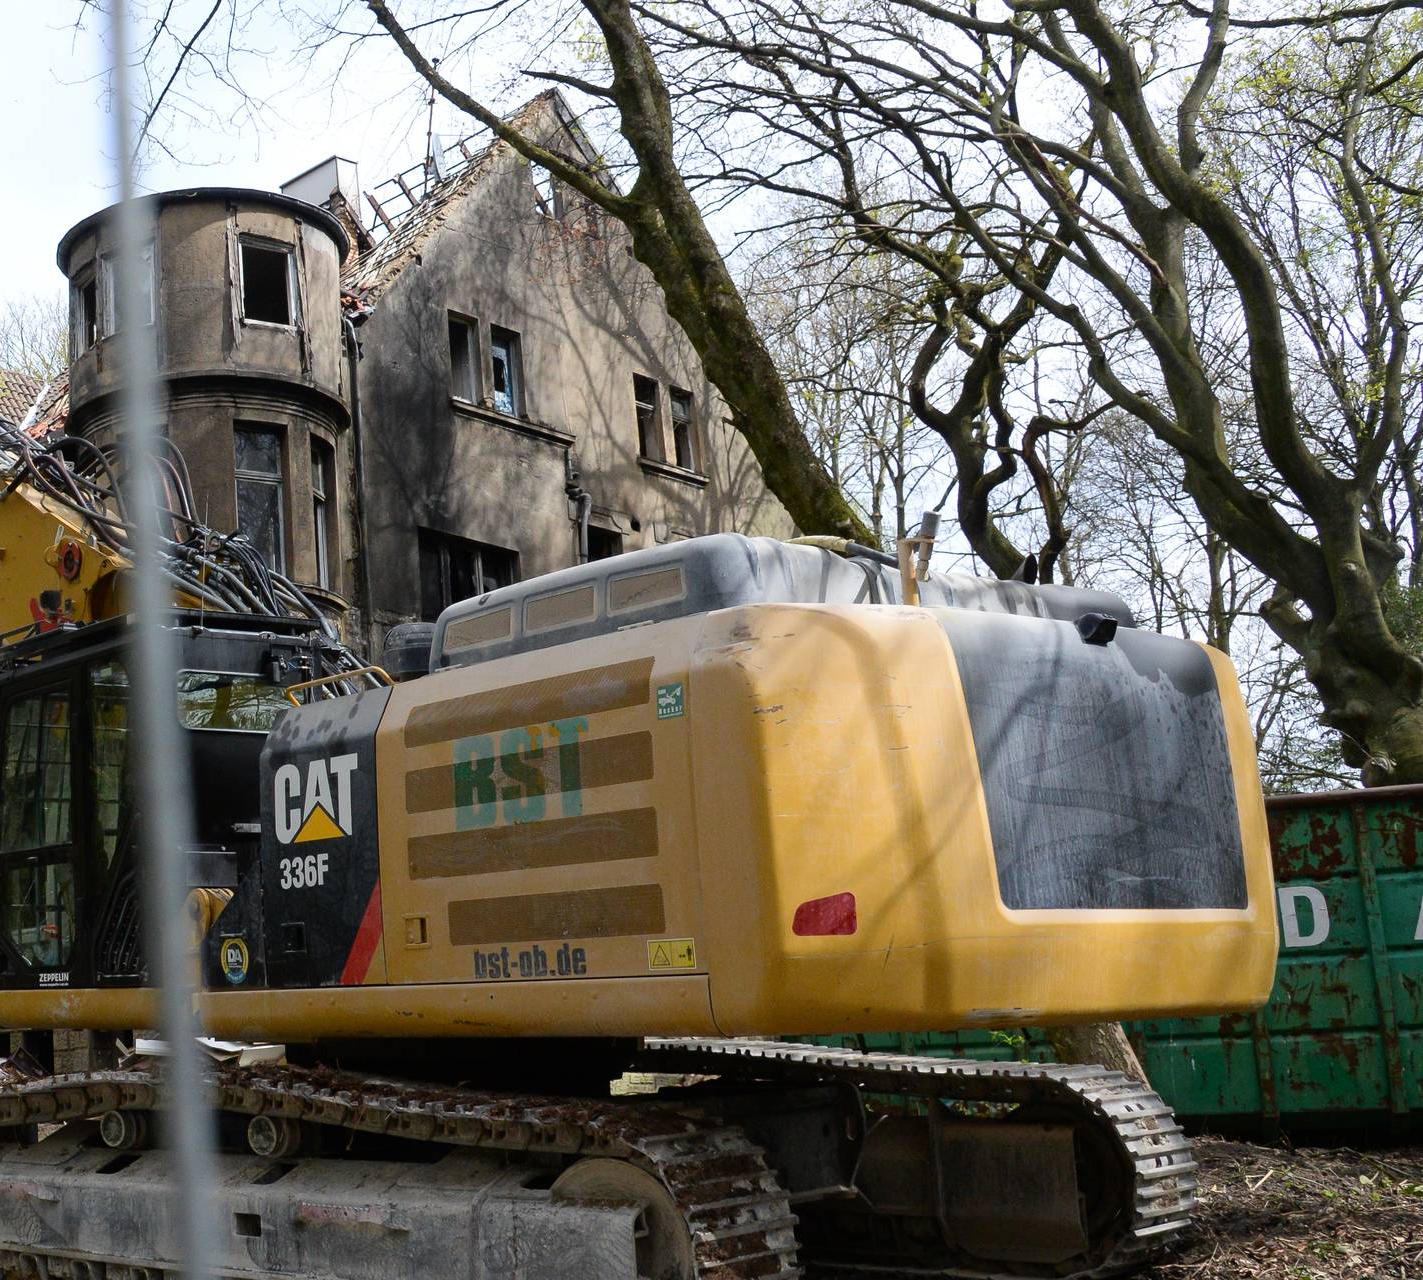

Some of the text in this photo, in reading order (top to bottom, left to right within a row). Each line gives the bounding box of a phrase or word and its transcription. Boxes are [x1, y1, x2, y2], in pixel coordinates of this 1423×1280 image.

[454, 714, 589, 832] BST
[274, 752, 358, 844] CAT
[280, 853, 329, 890] 336F
[39, 972, 69, 982] ZEPPELIN
[474, 943, 587, 979] bst-ob.de
